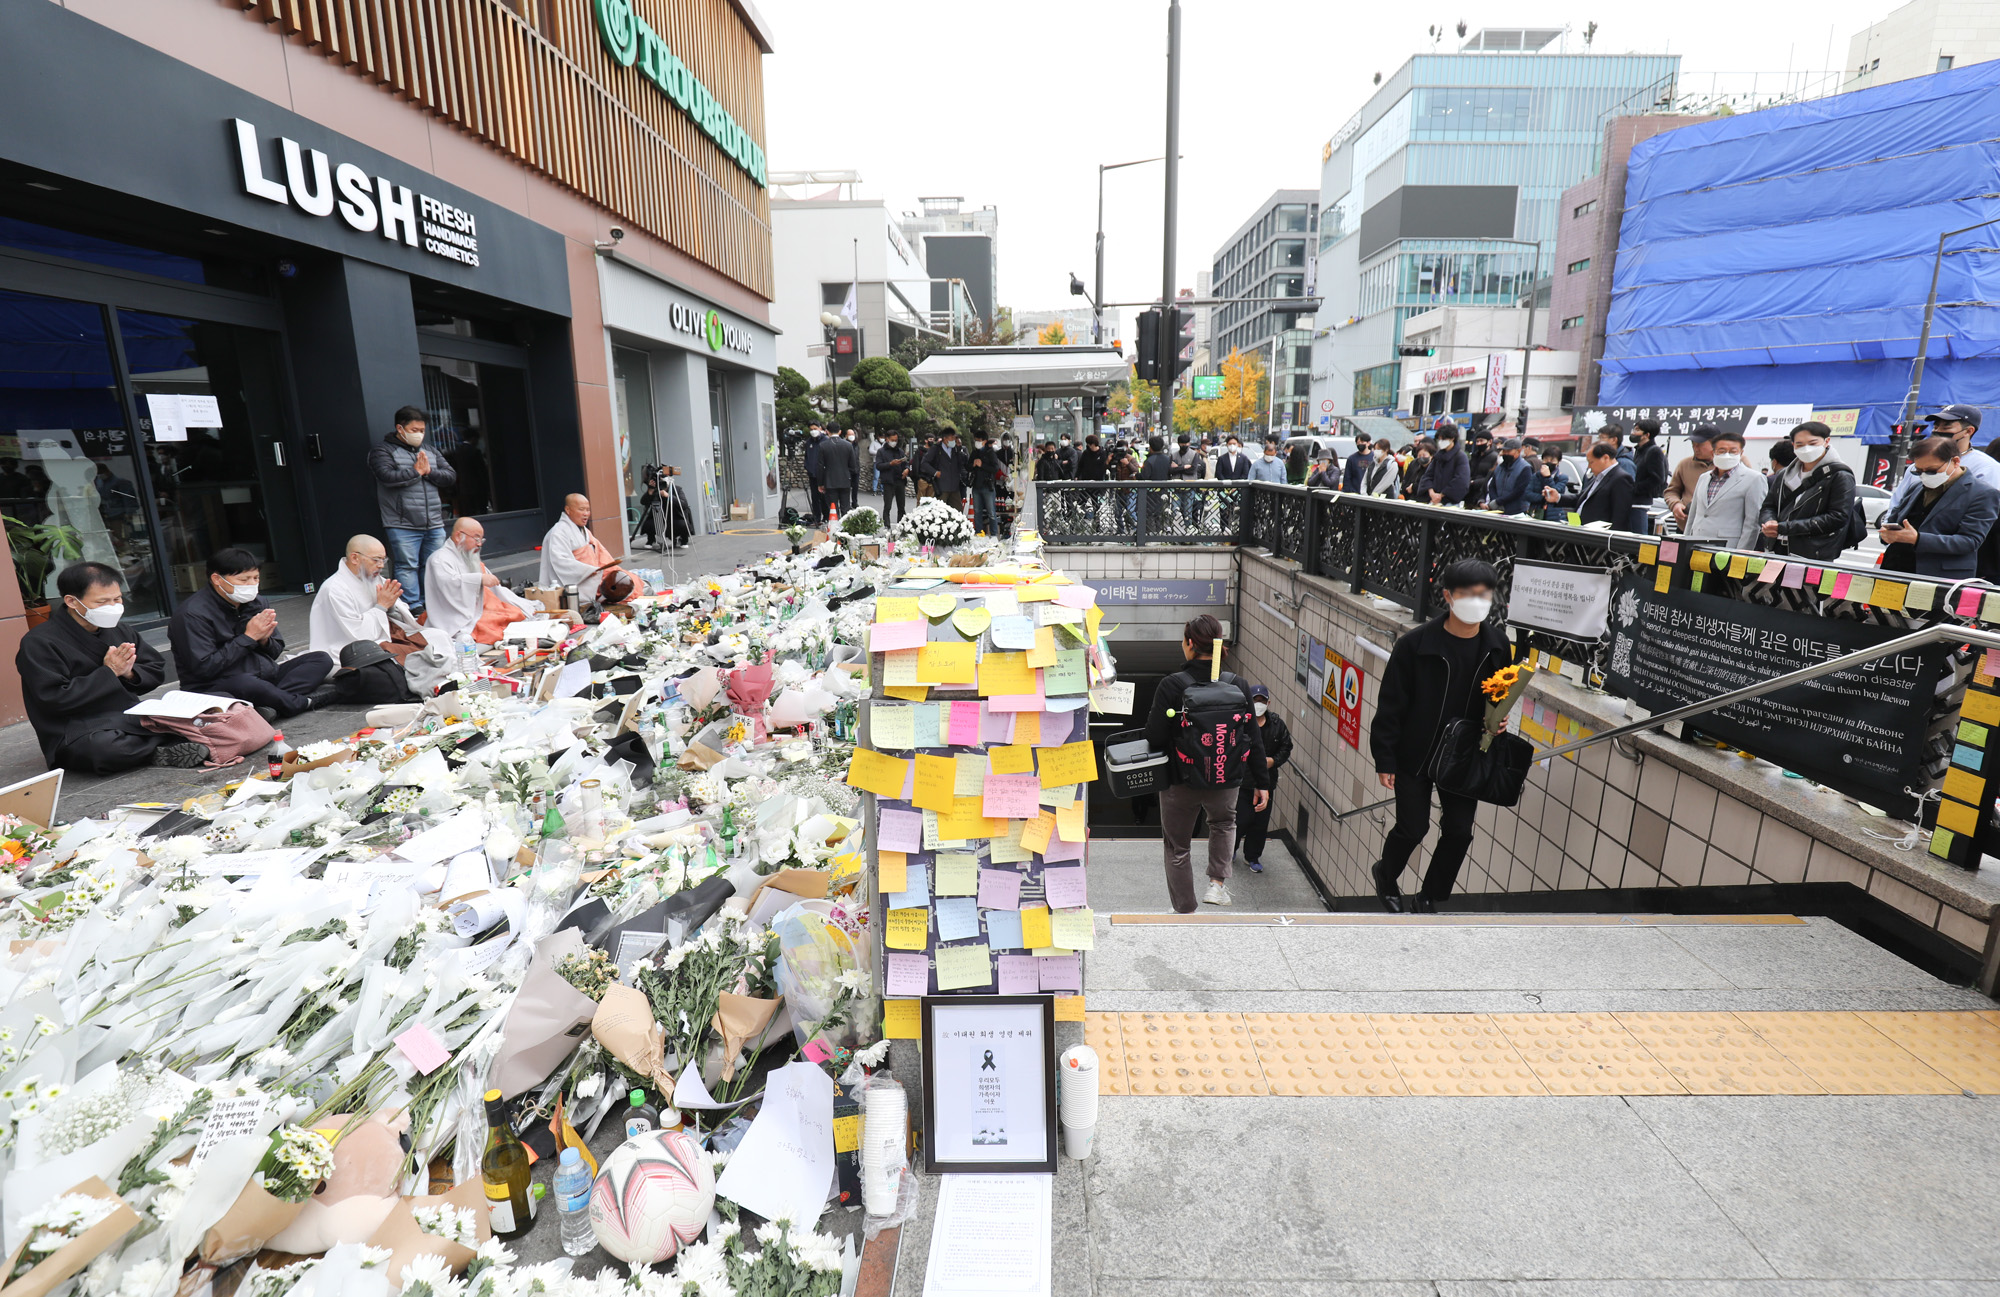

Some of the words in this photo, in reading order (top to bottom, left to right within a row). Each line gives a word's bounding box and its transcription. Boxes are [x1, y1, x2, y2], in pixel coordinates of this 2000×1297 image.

[636, 16, 767, 188] TROUBADOUR
[234, 117, 419, 247] LUSH
[420, 194, 476, 236] FRESH
[423, 221, 478, 252] HANDMADE
[425, 238, 480, 268] COSMETICS
[672, 302, 707, 338] OLIVE
[721, 322, 753, 354] YOUNG
[1490, 356, 1502, 407] TRANS
[1324, 402, 1333, 410] 50
[1612, 408, 1650, 421] 이태원
[1655, 407, 1682, 421] 참사
[1689, 407, 1744, 422] 희생자의
[1771, 416, 1803, 426] 국민의힘
[1101, 586, 1138, 600] 이태원
[1208, 583, 1214, 595] 1
[1579, 595, 1596, 603] 빕니다
[1643, 601, 1668, 623] 이태원
[1670, 608, 1693, 629] 참사
[1694, 614, 1757, 646] 희생자들께
[1760, 629, 1788, 653] 깊은
[1792, 637, 1844, 662] 애도를
[1646, 621, 1661, 633] send
[1661, 626, 1672, 635] our
[1672, 627, 1699, 643] deepest
[1699, 637, 1743, 655] condolences
[1744, 649, 1753, 657] to
[1754, 651, 1768, 661] the
[1769, 653, 1801, 669] victims
[1871, 672, 1917, 691] disaster
[1708, 652, 1720, 662] chia
[1735, 660, 1746, 669] sâu
[1880, 692, 1910, 707] Itaewon
[1340, 707, 1357, 729] 대피소
[1762, 698, 1799, 714] жертвам
[1800, 707, 1844, 724] трагедии
[1845, 717, 1856, 726] на
[1764, 711, 1809, 729] ЭМГЭНЭЛ
[1809, 721, 1865, 745] ИЛЭРХИЙЛЖ
[1866, 736, 1903, 755] БАЙНА
[1214, 723, 1228, 784] MoveSport
[1126, 771, 1154, 781] GOOSE
[1127, 777, 1154, 786] ISLAND
[953, 1030, 976, 1039] 이태원
[980, 1030, 994, 1039] 희생
[998, 1030, 1013, 1039] 영령
